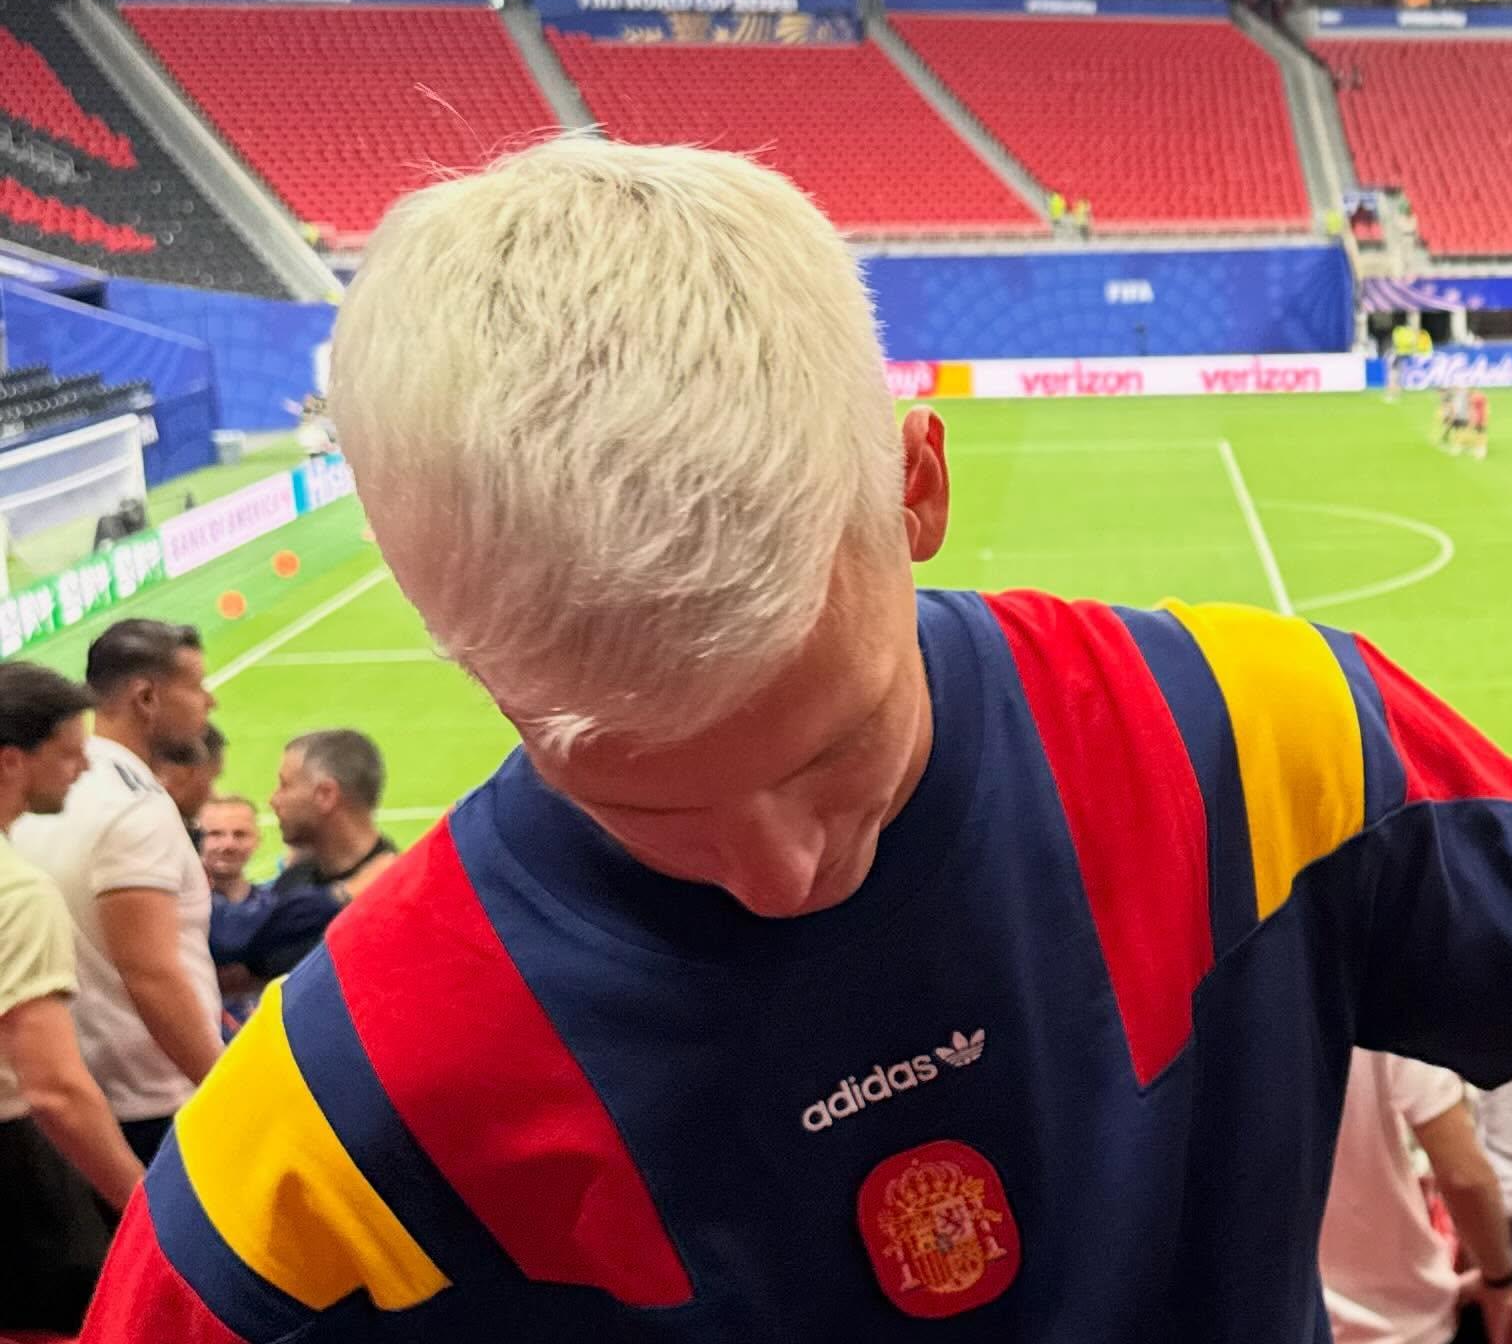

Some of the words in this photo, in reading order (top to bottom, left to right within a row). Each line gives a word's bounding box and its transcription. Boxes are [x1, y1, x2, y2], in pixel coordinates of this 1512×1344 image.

[1105, 280, 1154, 304] FIFA
[1020, 360, 1143, 397] verizon
[1200, 358, 1321, 394] verizon
[802, 1055, 938, 1132] adidas
